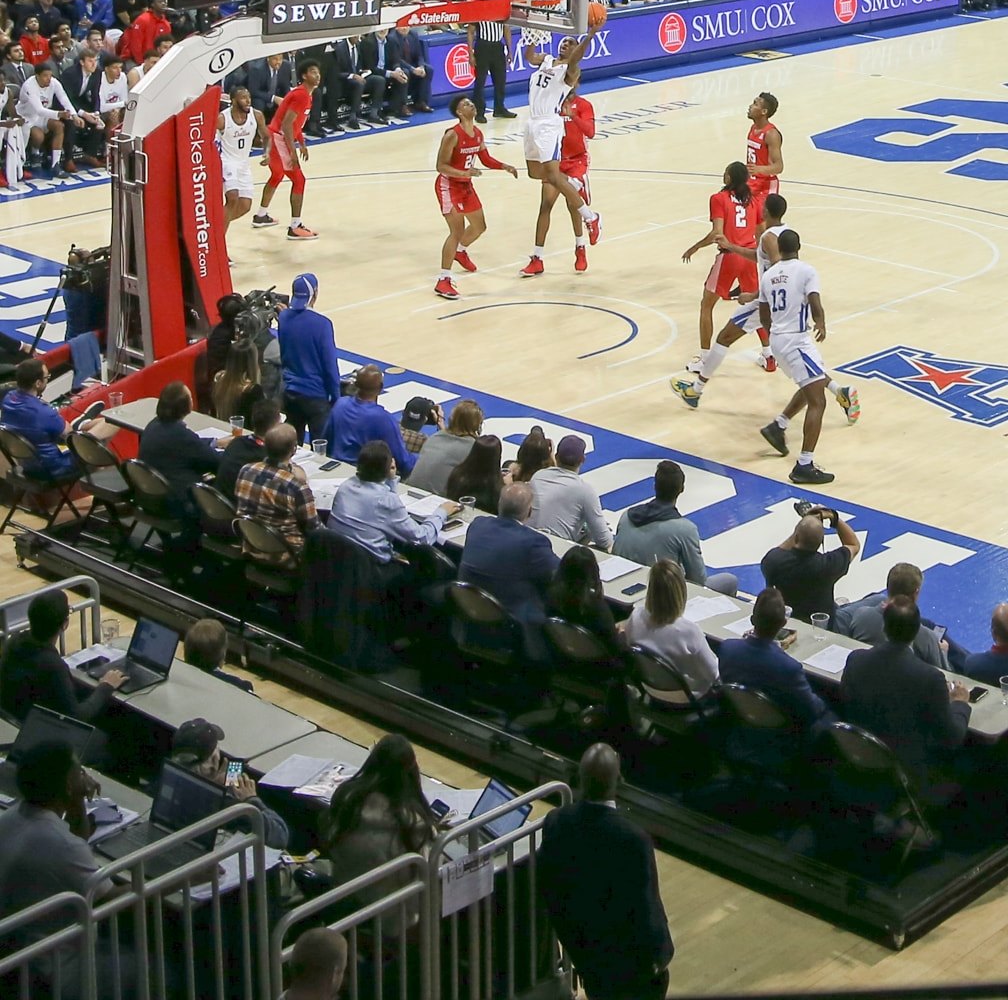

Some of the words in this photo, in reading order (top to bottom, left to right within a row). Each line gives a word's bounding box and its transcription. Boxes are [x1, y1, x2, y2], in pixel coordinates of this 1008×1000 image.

[751, 6, 796, 32] COX
[534, 74, 552, 89] 15
[238, 139, 244, 149] 0
[736, 206, 746, 228] 2
[770, 289, 786, 312] 13
